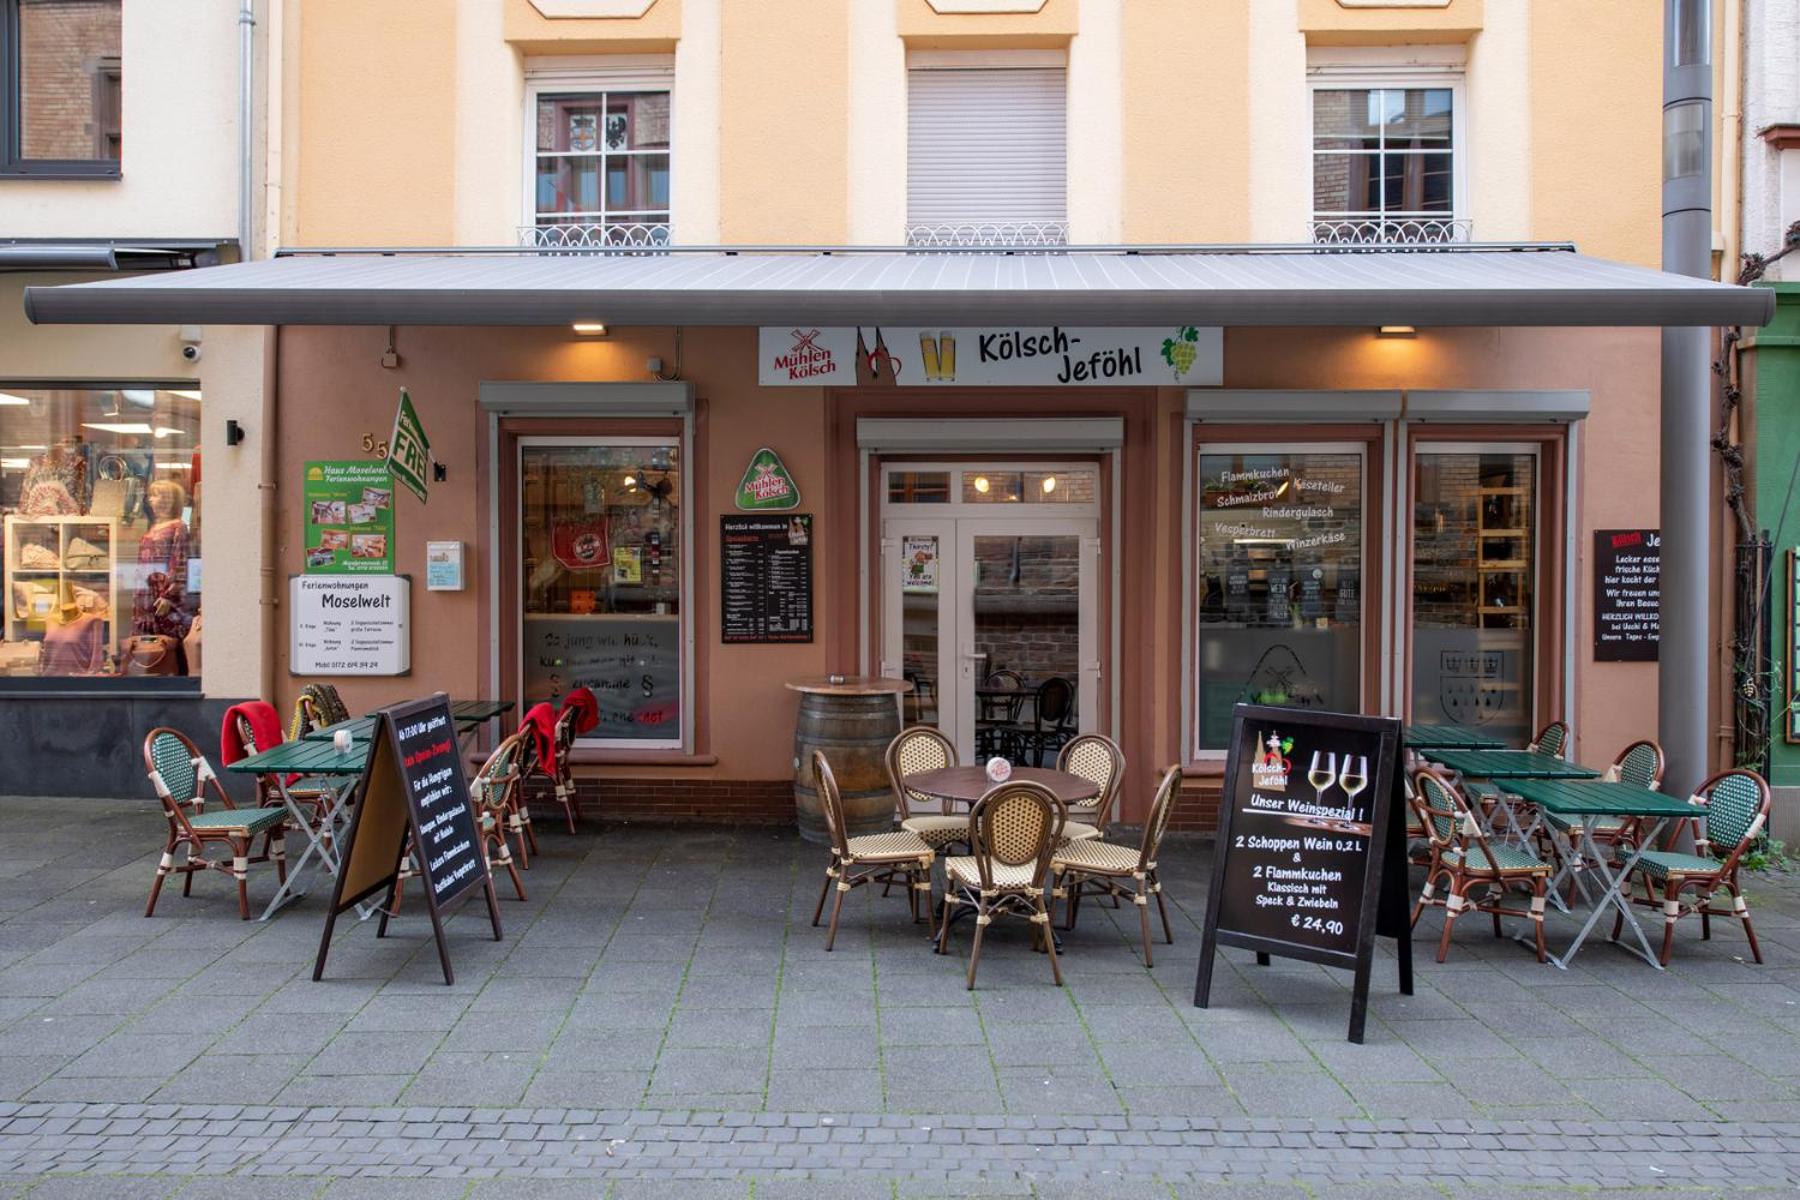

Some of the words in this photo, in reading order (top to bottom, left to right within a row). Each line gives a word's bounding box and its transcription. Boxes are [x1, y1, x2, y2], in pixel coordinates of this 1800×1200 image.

[979, 327, 1081, 362] Kölsch-
[774, 349, 832, 371] Mühlen
[1057, 347, 1142, 384] Jeföhl
[788, 360, 836, 380] Kölsch
[1221, 468, 1290, 482] Flammkuchen
[1262, 507, 1334, 520] Rindergulasch
[1286, 532, 1345, 550] Winzerkäse
[302, 581, 369, 591] Ferienwohnungen
[1606, 589, 1619, 598] Wir
[322, 594, 391, 608] Moselwelt
[1252, 762, 1286, 774] Kölsch-
[1258, 775, 1288, 786] Jeföhl
[1251, 795, 1284, 809] Unser
[1288, 800, 1355, 820] Weinspezial
[1235, 836, 1244, 848] 2
[1248, 836, 1300, 852] Schoppen
[1304, 838, 1333, 851] Wein
[1336, 840, 1353, 853] 0,2
[1355, 841, 1363, 852] L
[1293, 852, 1302, 862] &
[1253, 866, 1262, 878] 2
[1266, 866, 1342, 882] Flammkuchen
[1268, 882, 1309, 893] Klassisch
[1311, 884, 1327, 894] mit
[1256, 895, 1283, 907] Speck
[1286, 896, 1295, 906] &
[1297, 897, 1339, 909] Zwiebeln
[1291, 915, 1300, 927] €
[1303, 917, 1344, 935] 24,90
